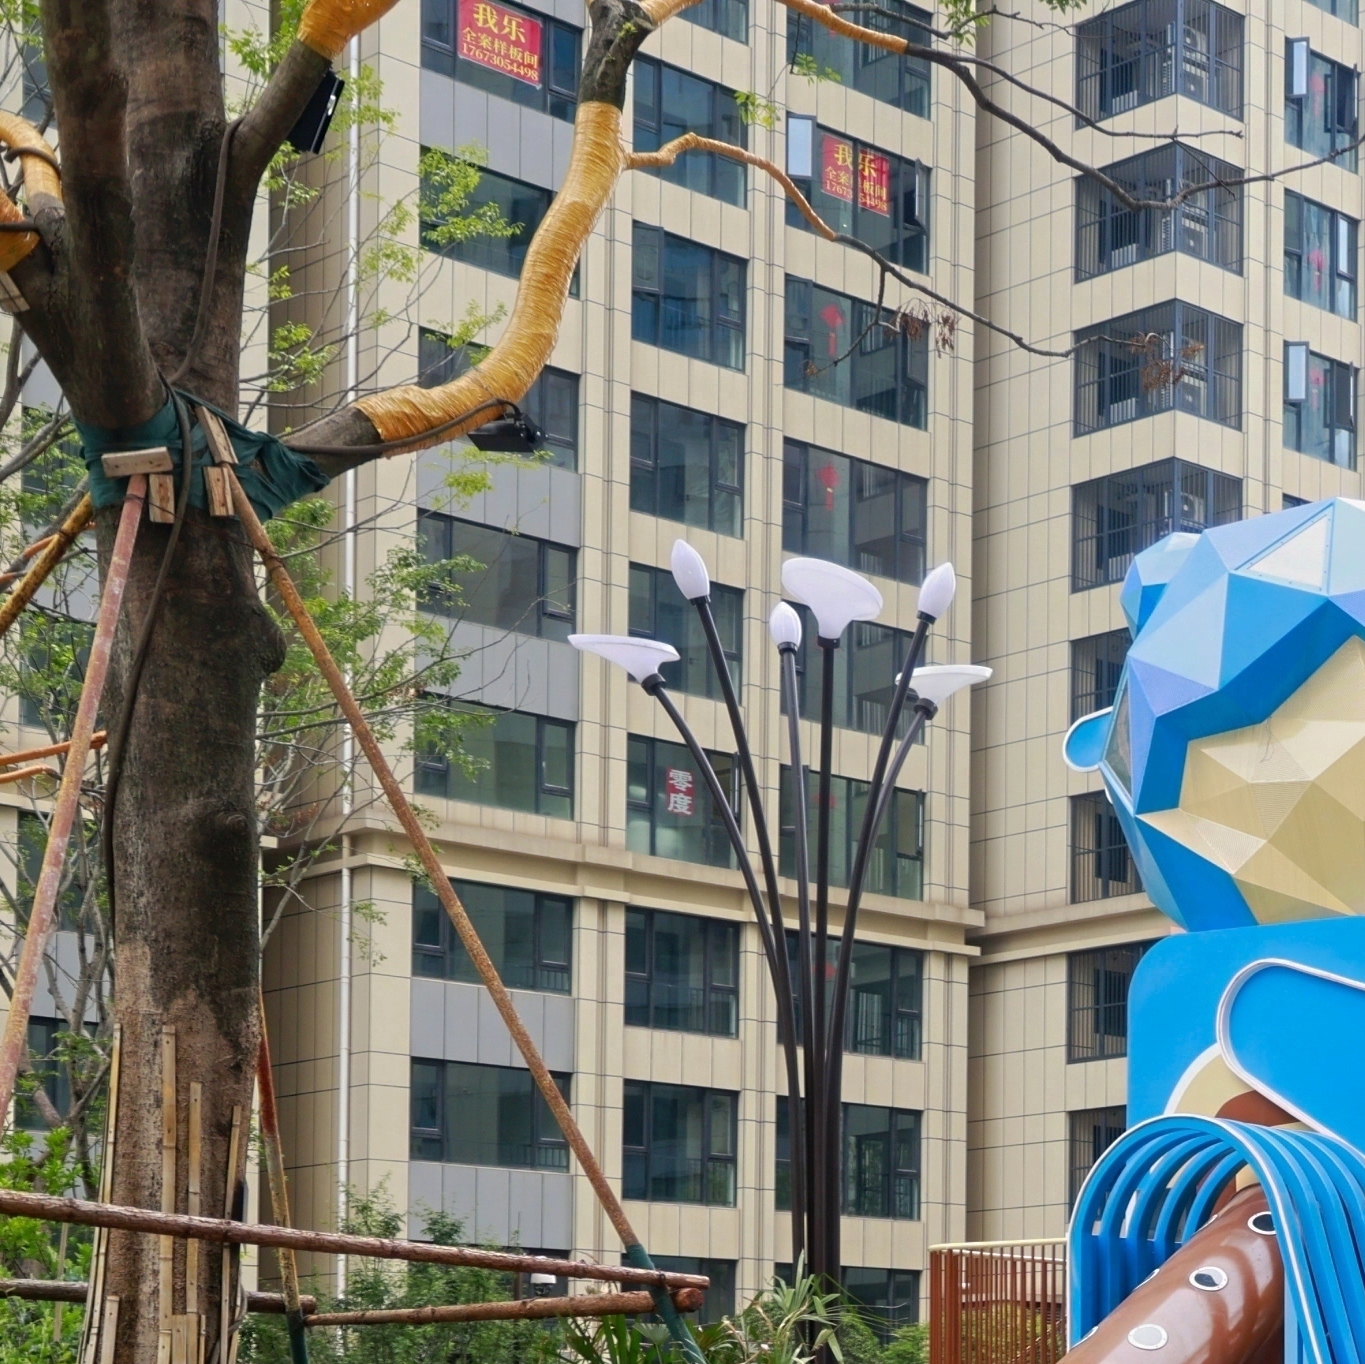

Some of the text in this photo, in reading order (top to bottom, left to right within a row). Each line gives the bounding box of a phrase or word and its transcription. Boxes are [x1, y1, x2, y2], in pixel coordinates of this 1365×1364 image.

[473, 3, 526, 43] 我乐
[463, 27, 538, 69] 全案样板间
[463, 43, 539, 81] 17673054498
[825, 166, 887, 201] 全案板间
[826, 180, 888, 212] 1767354498
[668, 769, 692, 815] 零度
